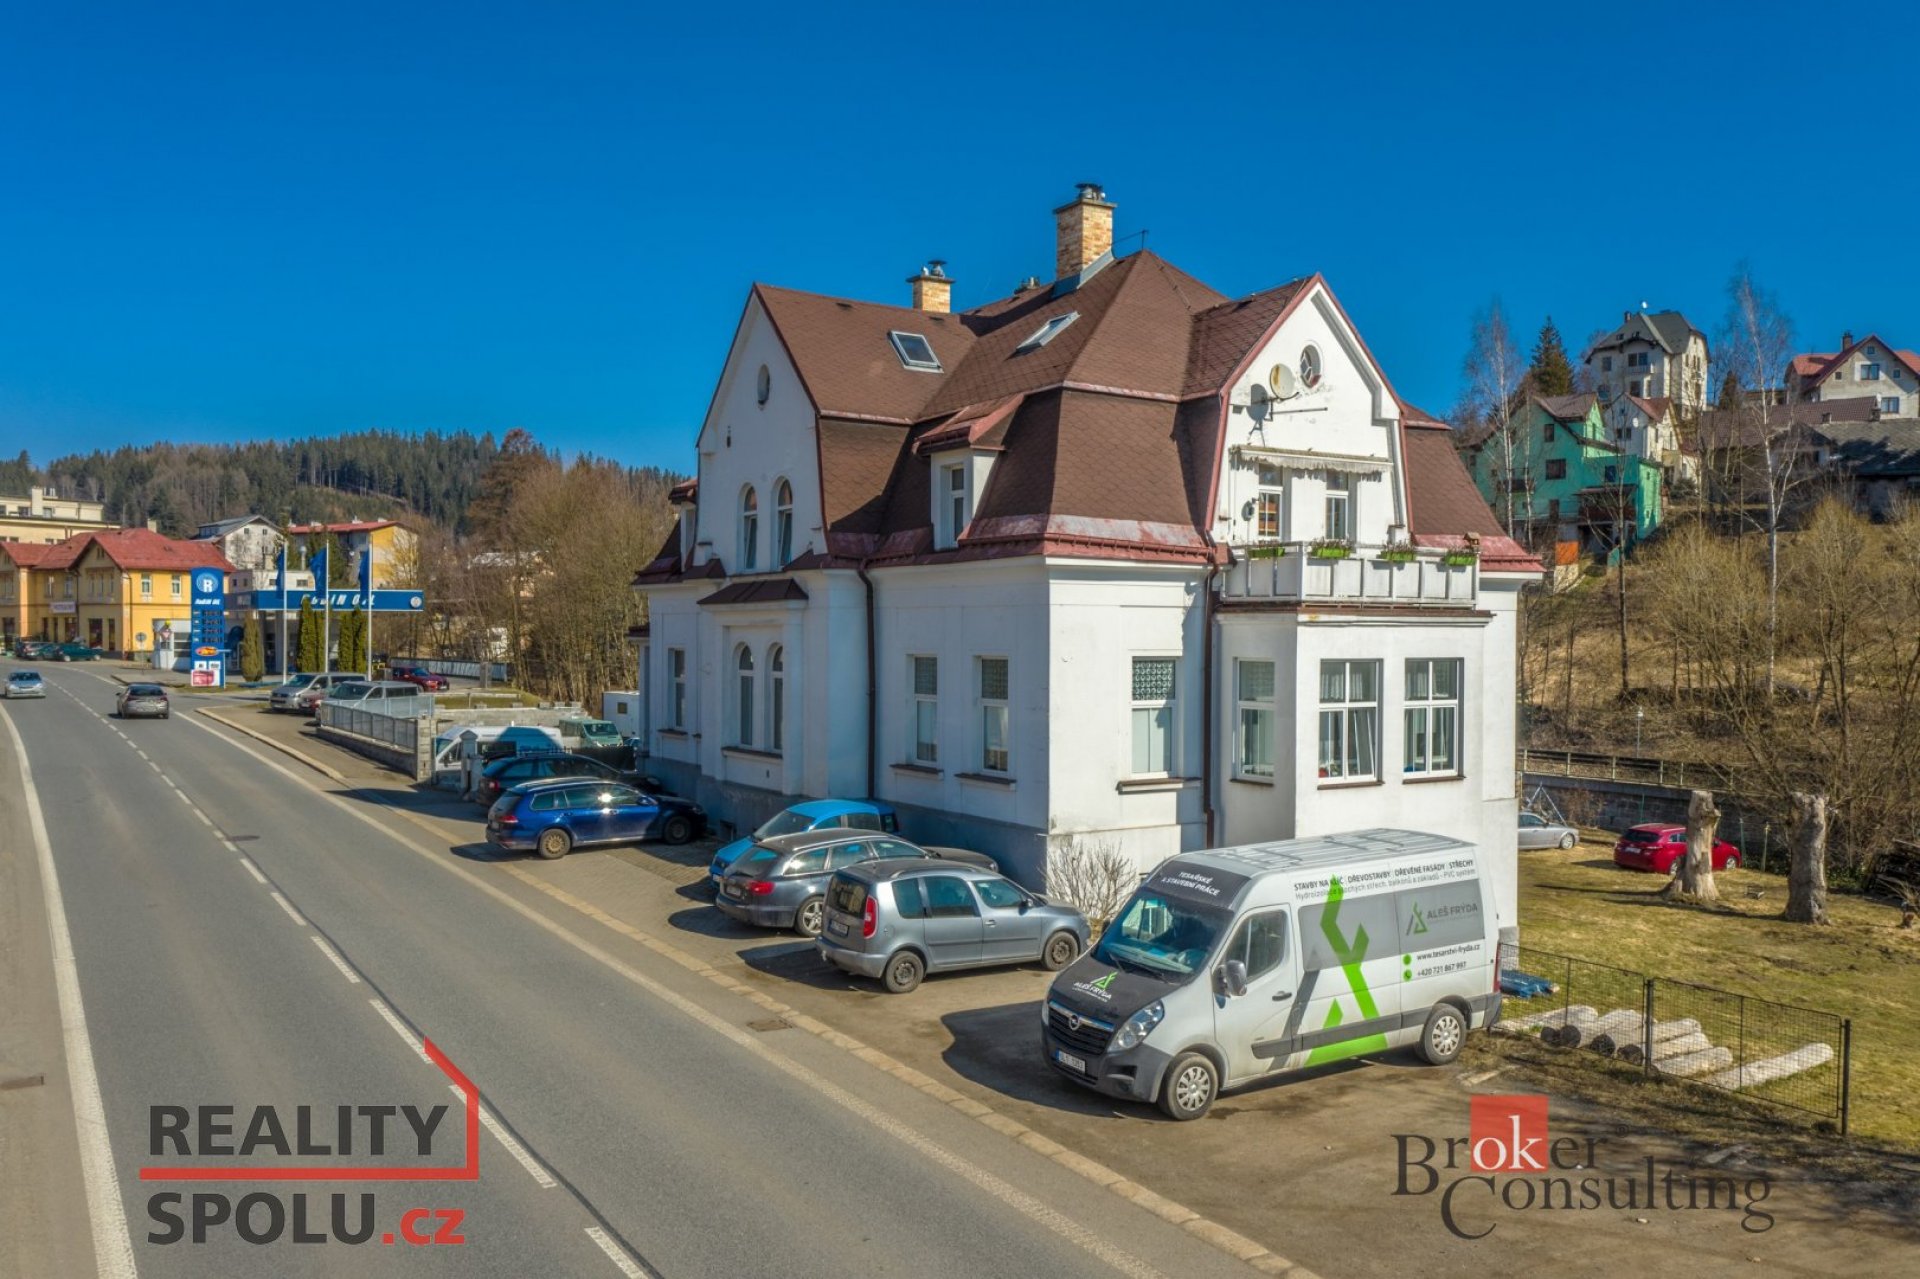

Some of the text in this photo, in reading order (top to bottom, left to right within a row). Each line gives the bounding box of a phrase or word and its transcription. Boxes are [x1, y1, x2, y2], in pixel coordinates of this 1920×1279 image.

[1294, 881, 1318, 891] STAVBY
[1319, 879, 1329, 888] NA
[1347, 871, 1391, 883] DŘEVOSTAVBY
[1448, 859, 1473, 869] STŘECHY
[1195, 883, 1221, 896] PRÁCE
[1427, 905, 1449, 919] ALEŠ
[1450, 901, 1478, 915] FRÝDA
